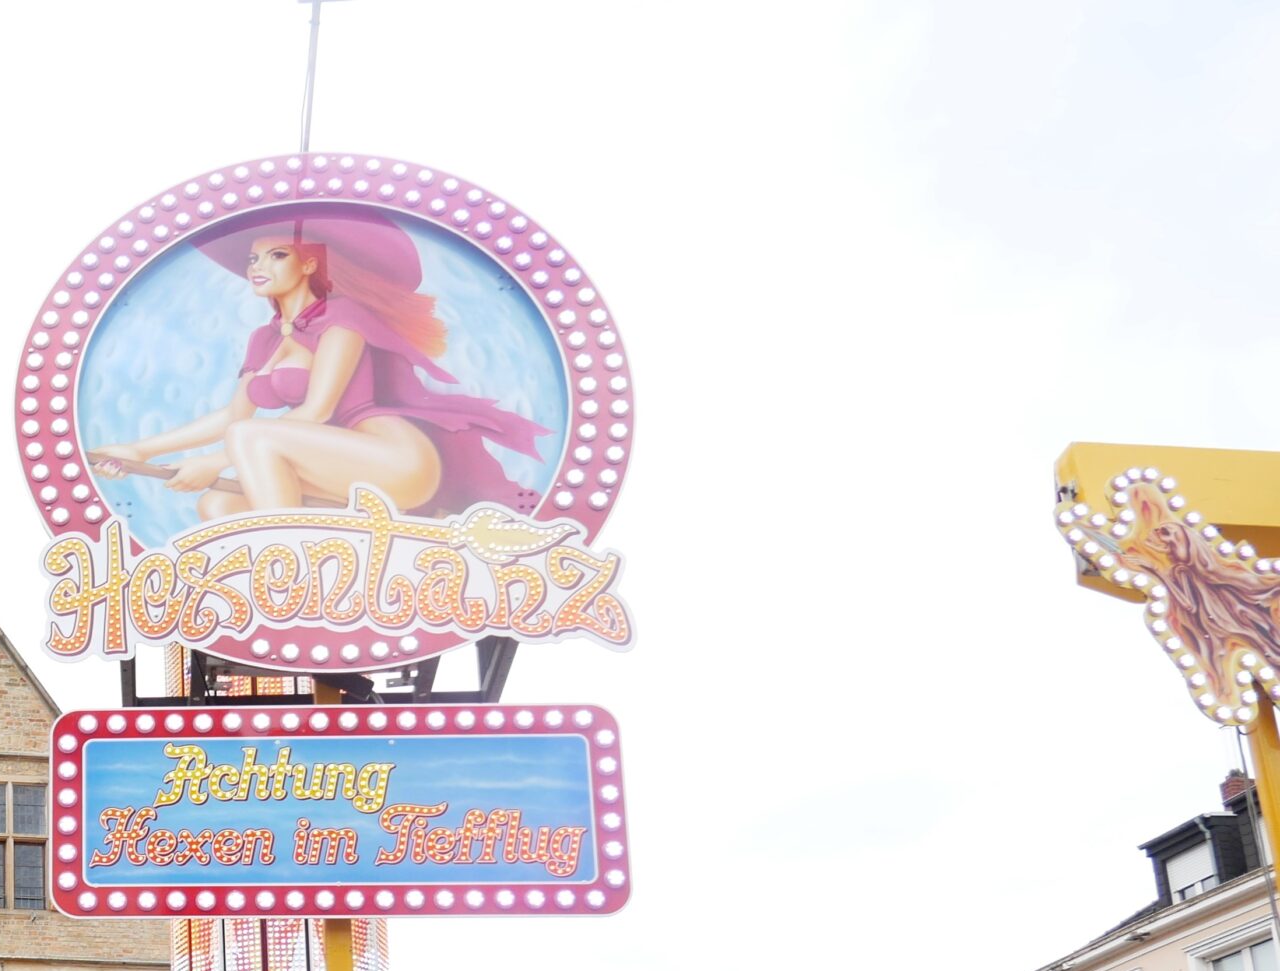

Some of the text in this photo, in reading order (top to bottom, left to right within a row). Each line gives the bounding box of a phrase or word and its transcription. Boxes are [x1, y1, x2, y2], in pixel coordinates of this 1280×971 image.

[44, 487, 632, 655] Hexentanz
[153, 742, 397, 813] Achtung
[89, 802, 588, 877] Hexen im Tiefflug
